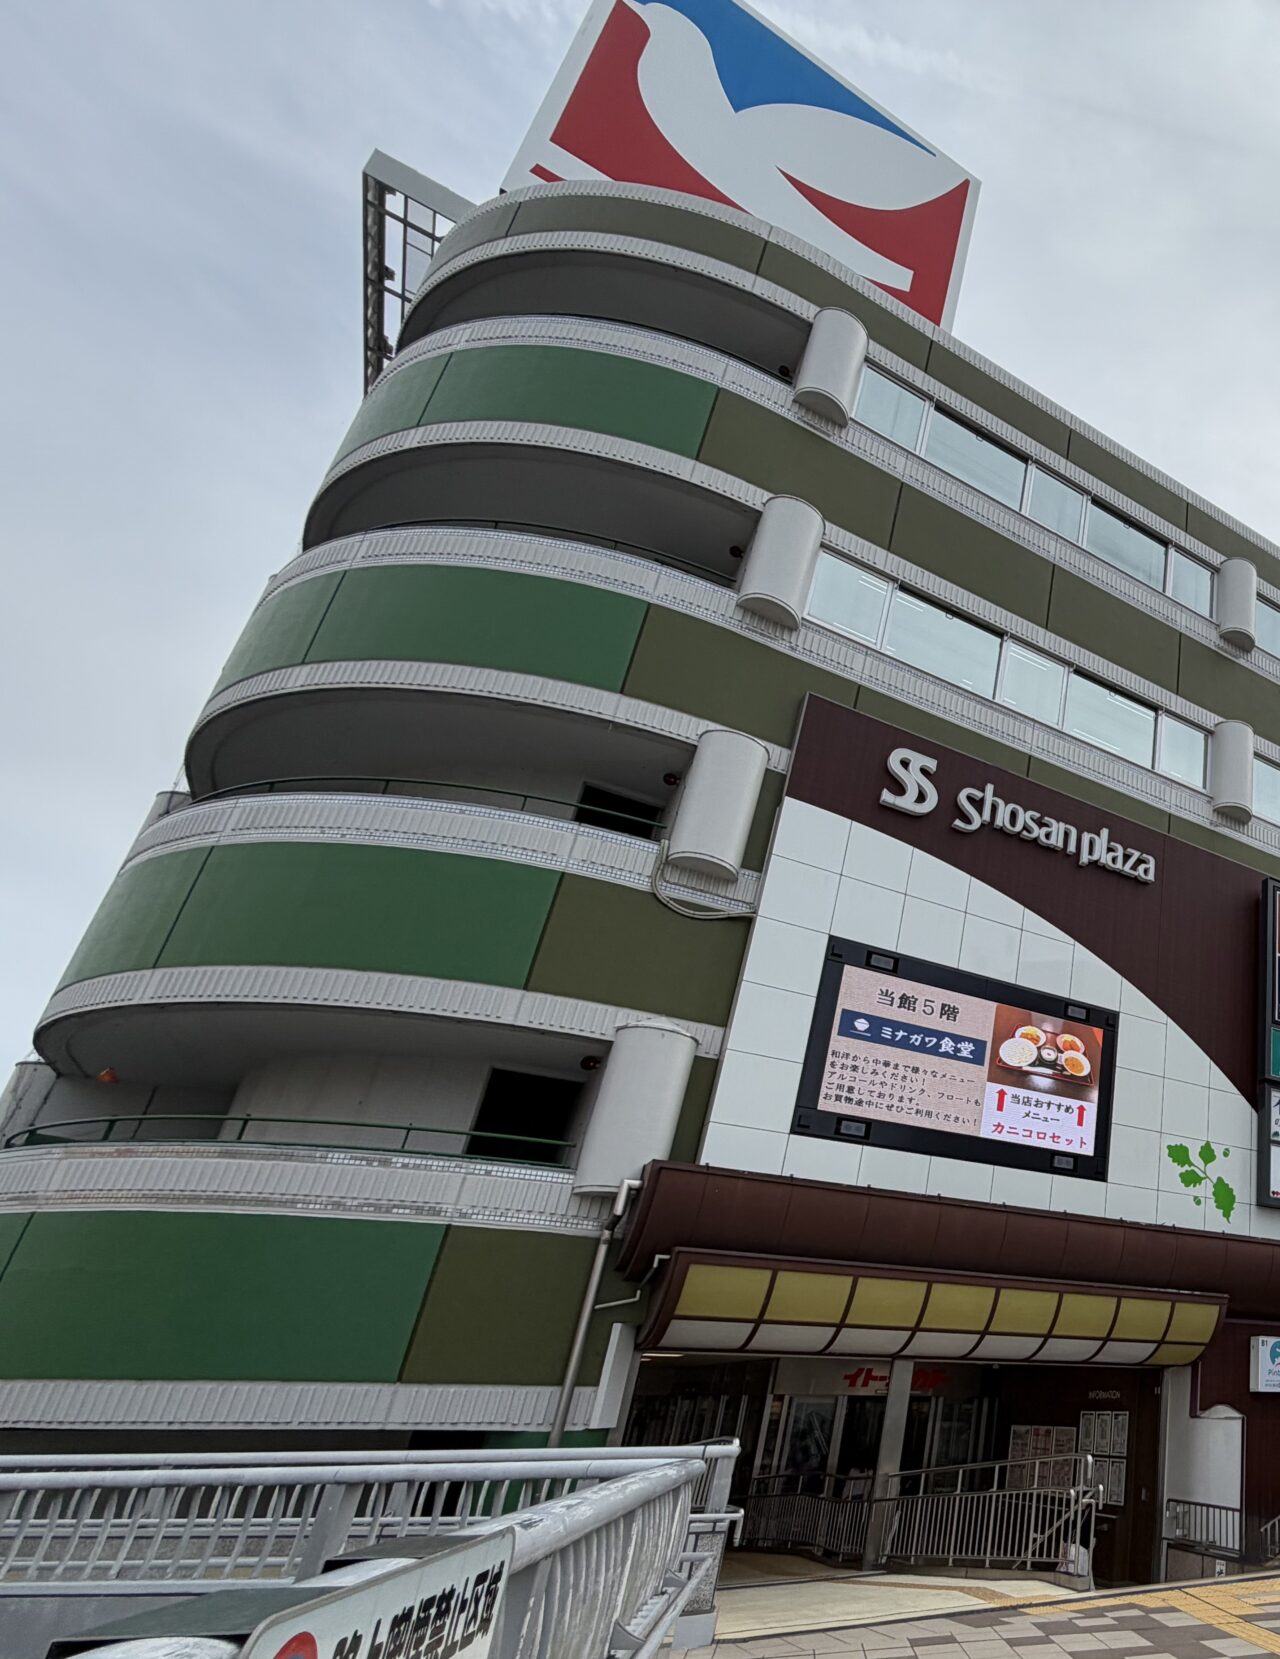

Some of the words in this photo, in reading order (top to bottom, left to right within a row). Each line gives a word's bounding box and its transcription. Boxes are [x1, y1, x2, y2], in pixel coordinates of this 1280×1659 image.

[951, 782, 1078, 857] Shosan
[1078, 826, 1157, 884] plaza
[880, 1025, 976, 1059] ミナガワ食堂
[830, 1049, 977, 1084] 和洋から中華まで様々なメニュー
[1010, 1093, 1076, 1116] 当店おすすめ
[1021, 1109, 1061, 1124] メニュー
[991, 1121, 1088, 1149] カニコロセット
